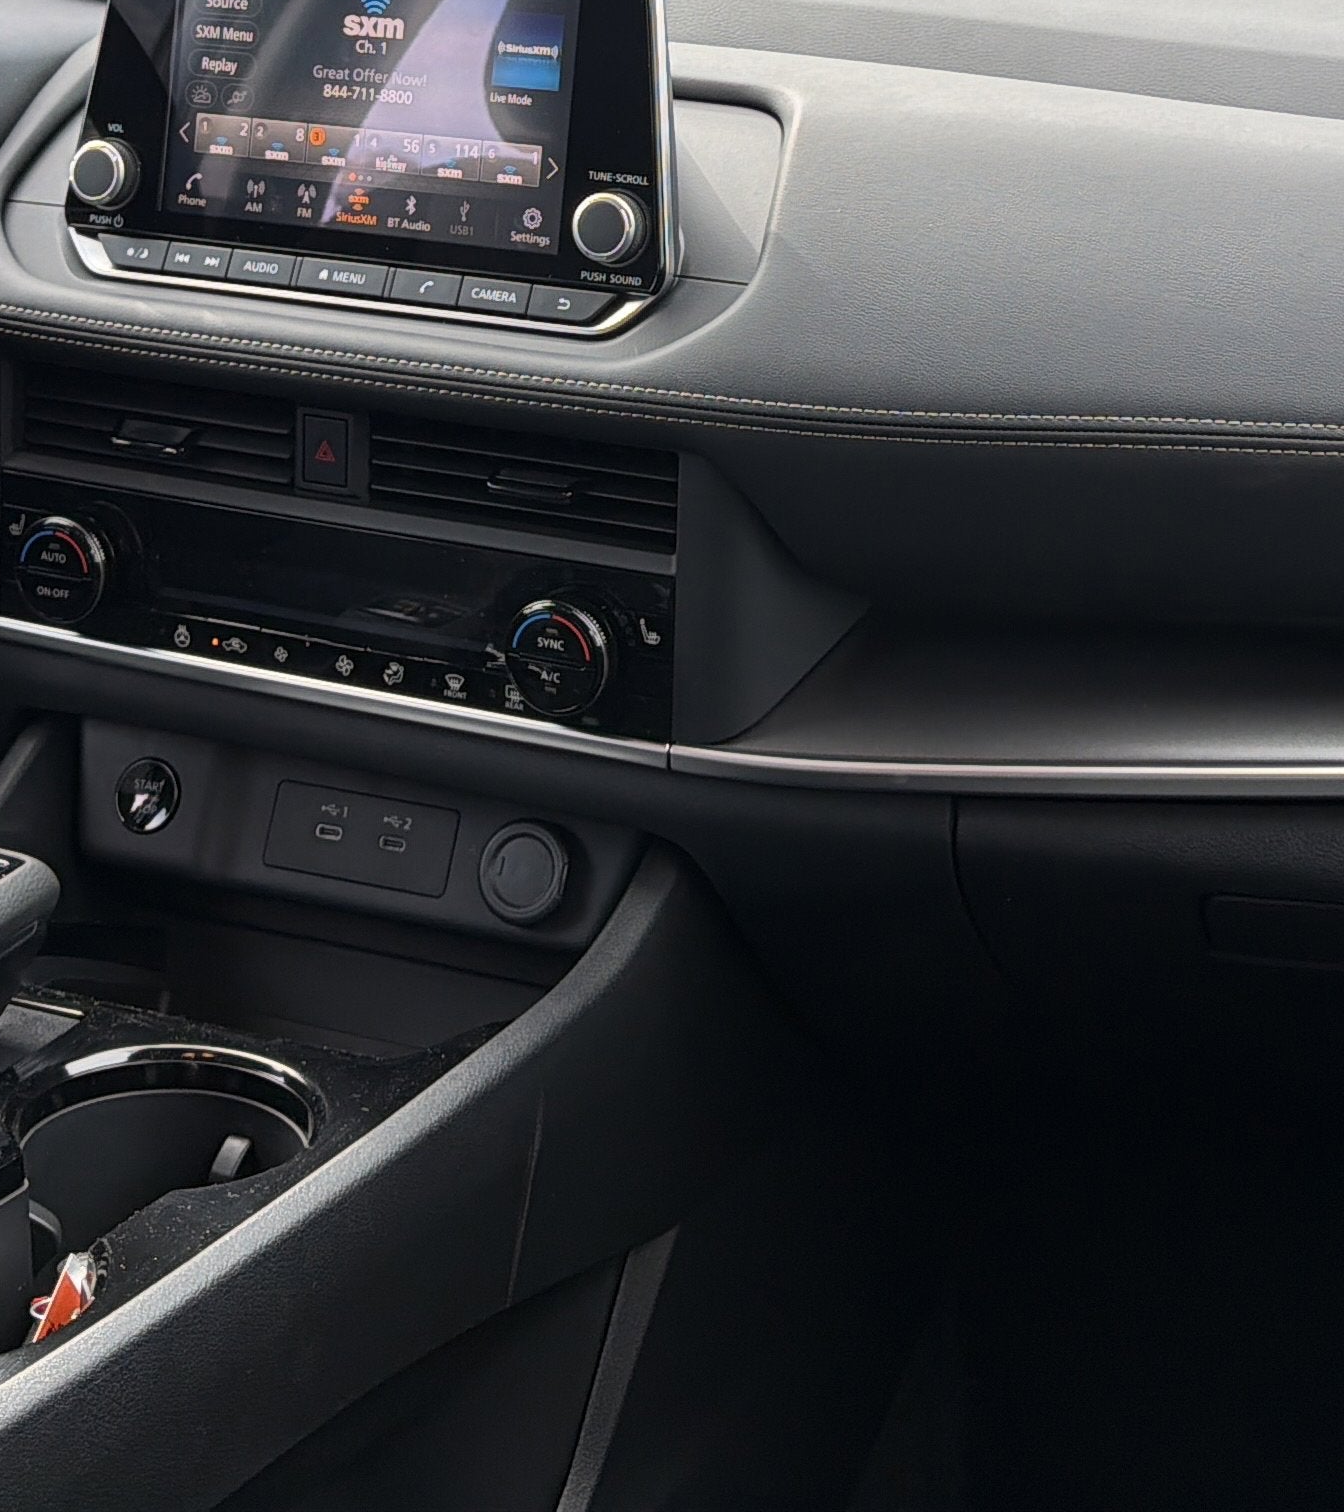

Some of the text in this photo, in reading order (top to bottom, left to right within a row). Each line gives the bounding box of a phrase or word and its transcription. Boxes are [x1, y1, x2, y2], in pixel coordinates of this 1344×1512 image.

[196, 24, 254, 43] SXM Menu
[343, 14, 405, 40] sxm
[356, 40, 387, 56] Ch. 1
[201, 56, 238, 76] Replay
[312, 64, 428, 88] Great Offer Now!
[323, 83, 413, 105] 844-711-8800
[489, 91, 533, 107] Live Mode
[107, 123, 125, 134] VOL
[239, 122, 249, 137] 2
[256, 125, 265, 137] 2
[295, 127, 305, 142] 8
[209, 144, 234, 156] sxm
[369, 137, 378, 148] 4
[403, 139, 421, 154] 56
[428, 144, 436, 155] 5
[264, 150, 289, 161] sxm
[455, 143, 479, 159] 114
[488, 148, 496, 159] 6
[321, 156, 346, 167] sxm
[437, 167, 463, 180] sxm
[496, 173, 523, 185] sxm
[177, 193, 207, 208] Phone
[244, 201, 263, 214] AM
[89, 214, 112, 226] PUSH
[296, 207, 313, 219] FM
[336, 211, 378, 226] SiriusXM
[387, 217, 432, 233] BT Audio
[450, 224, 474, 237] USB1
[510, 230, 551, 248] Settings
[243, 260, 280, 275] AUDIO
[332, 271, 366, 285] MENU
[580, 270, 643, 287] PUSH SOUND
[471, 287, 518, 304] CAMERA
[40, 550, 67, 564] AUTO
[536, 636, 565, 652] SYNC
[540, 670, 561, 684] A/C
[443, 689, 468, 701] FRONT
[504, 701, 525, 712] REAR
[342, 804, 350, 819] 1
[404, 816, 413, 831] 2
